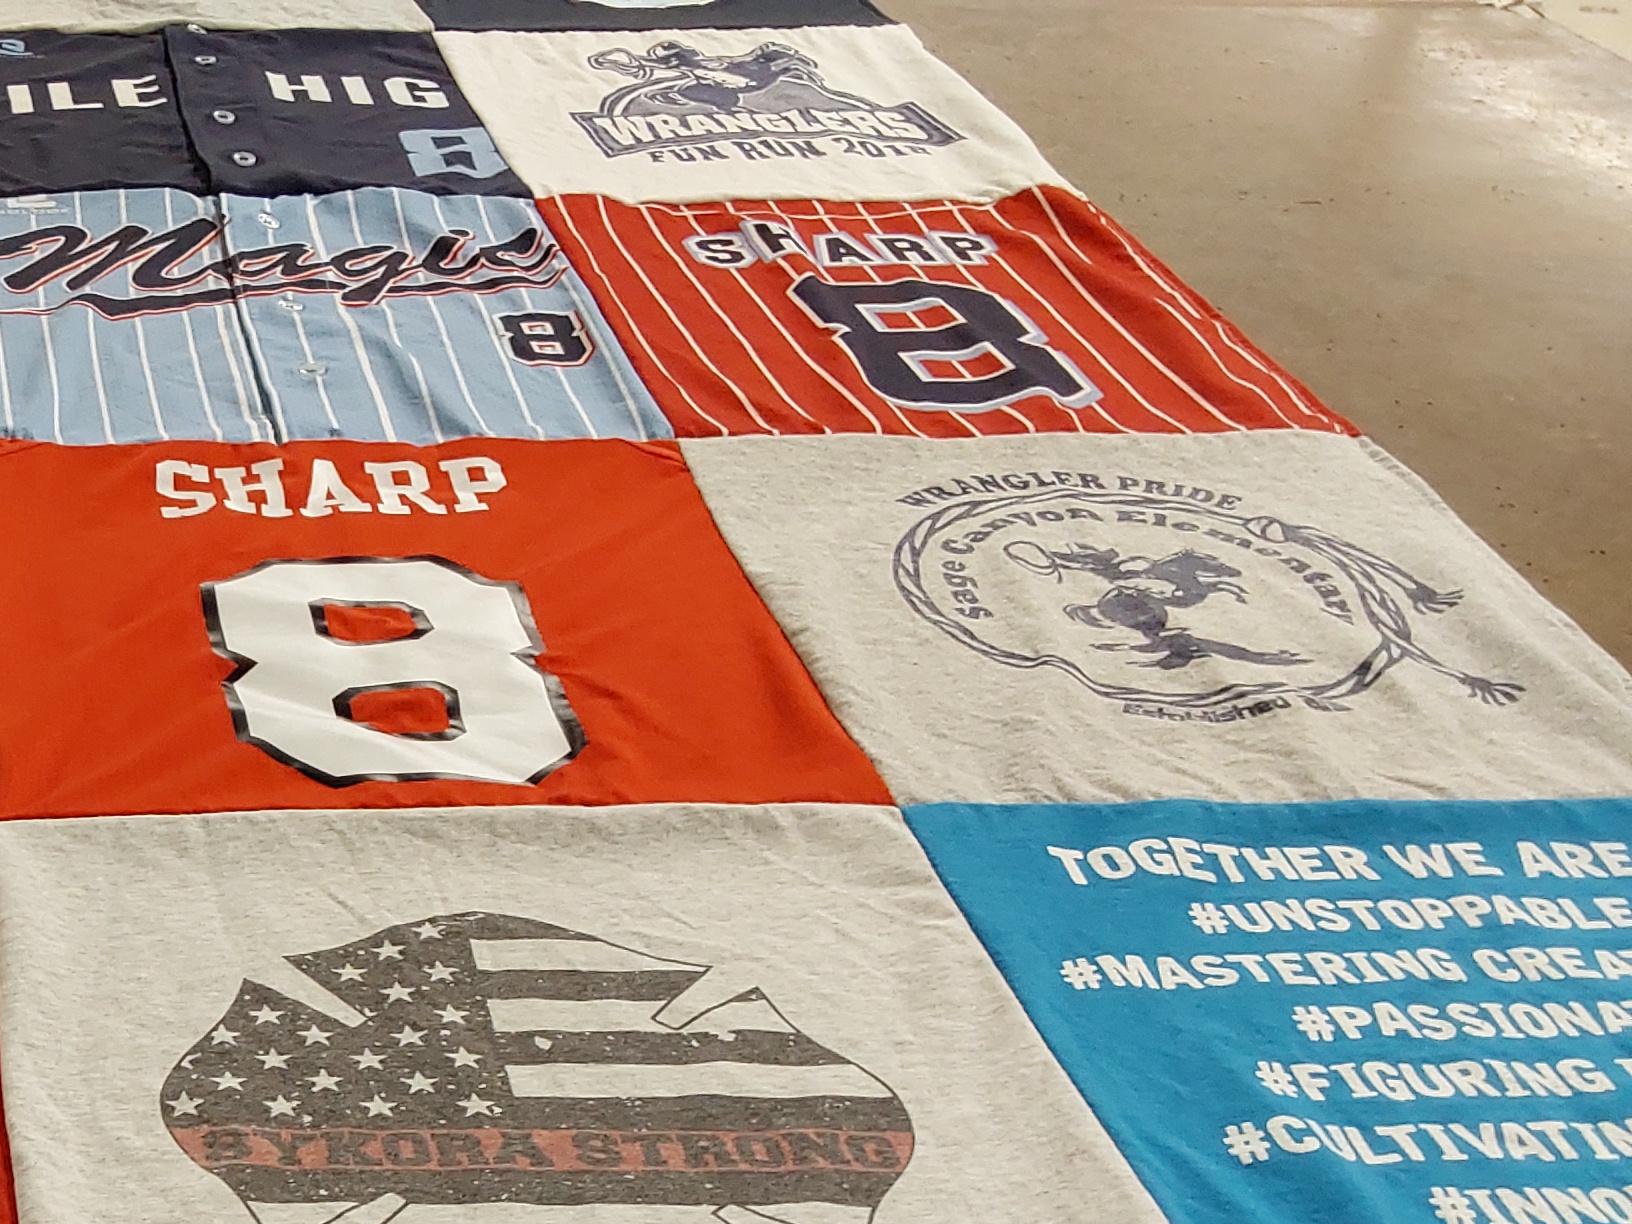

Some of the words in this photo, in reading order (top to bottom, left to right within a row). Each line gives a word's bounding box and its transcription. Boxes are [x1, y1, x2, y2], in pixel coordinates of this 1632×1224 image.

[264, 70, 450, 109] HIG
[592, 108, 931, 147] WRANGLERS
[398, 126, 509, 179] 8
[648, 145, 730, 164] FUN
[730, 138, 829, 162] RUN
[681, 219, 998, 270] SHARP
[494, 309, 596, 368] 8
[786, 271, 1105, 412] 8
[155, 455, 508, 519] SHARP
[896, 470, 1107, 509] WRANGLER
[1116, 475, 1244, 511] PRIDE
[940, 507, 1105, 556] Canyon
[199, 553, 589, 789] 8
[1047, 836, 1382, 886] TOGETHER
[1383, 841, 1504, 880] WE
[1514, 840, 1632, 879] ARE
[1188, 893, 1632, 935] #UNSTOPPABLE
[1060, 947, 1468, 991] #MASTERING
[1255, 1057, 1617, 1101] #FIGURING
[202, 1128, 550, 1170] SYKORA
[571, 1130, 906, 1171] STRONG
